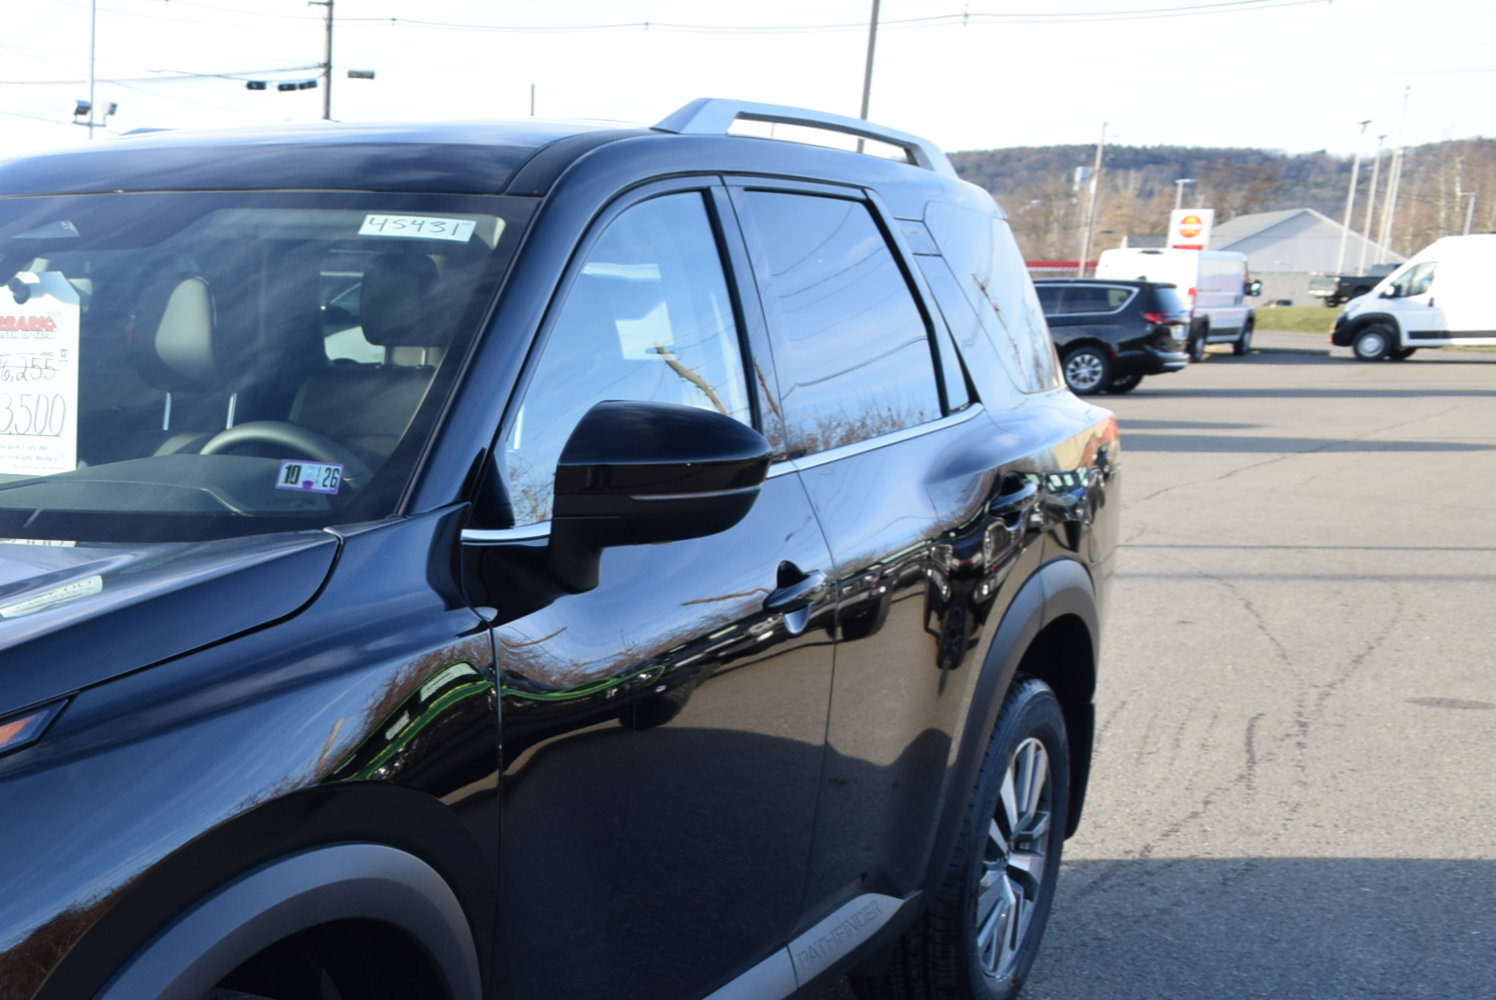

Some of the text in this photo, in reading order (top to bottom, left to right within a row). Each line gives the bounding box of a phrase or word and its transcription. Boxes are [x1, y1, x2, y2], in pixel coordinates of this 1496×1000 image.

[368, 216, 460, 236] 45431
[322, 467, 340, 488] 26
[795, 899, 883, 969] PATHFINDER
